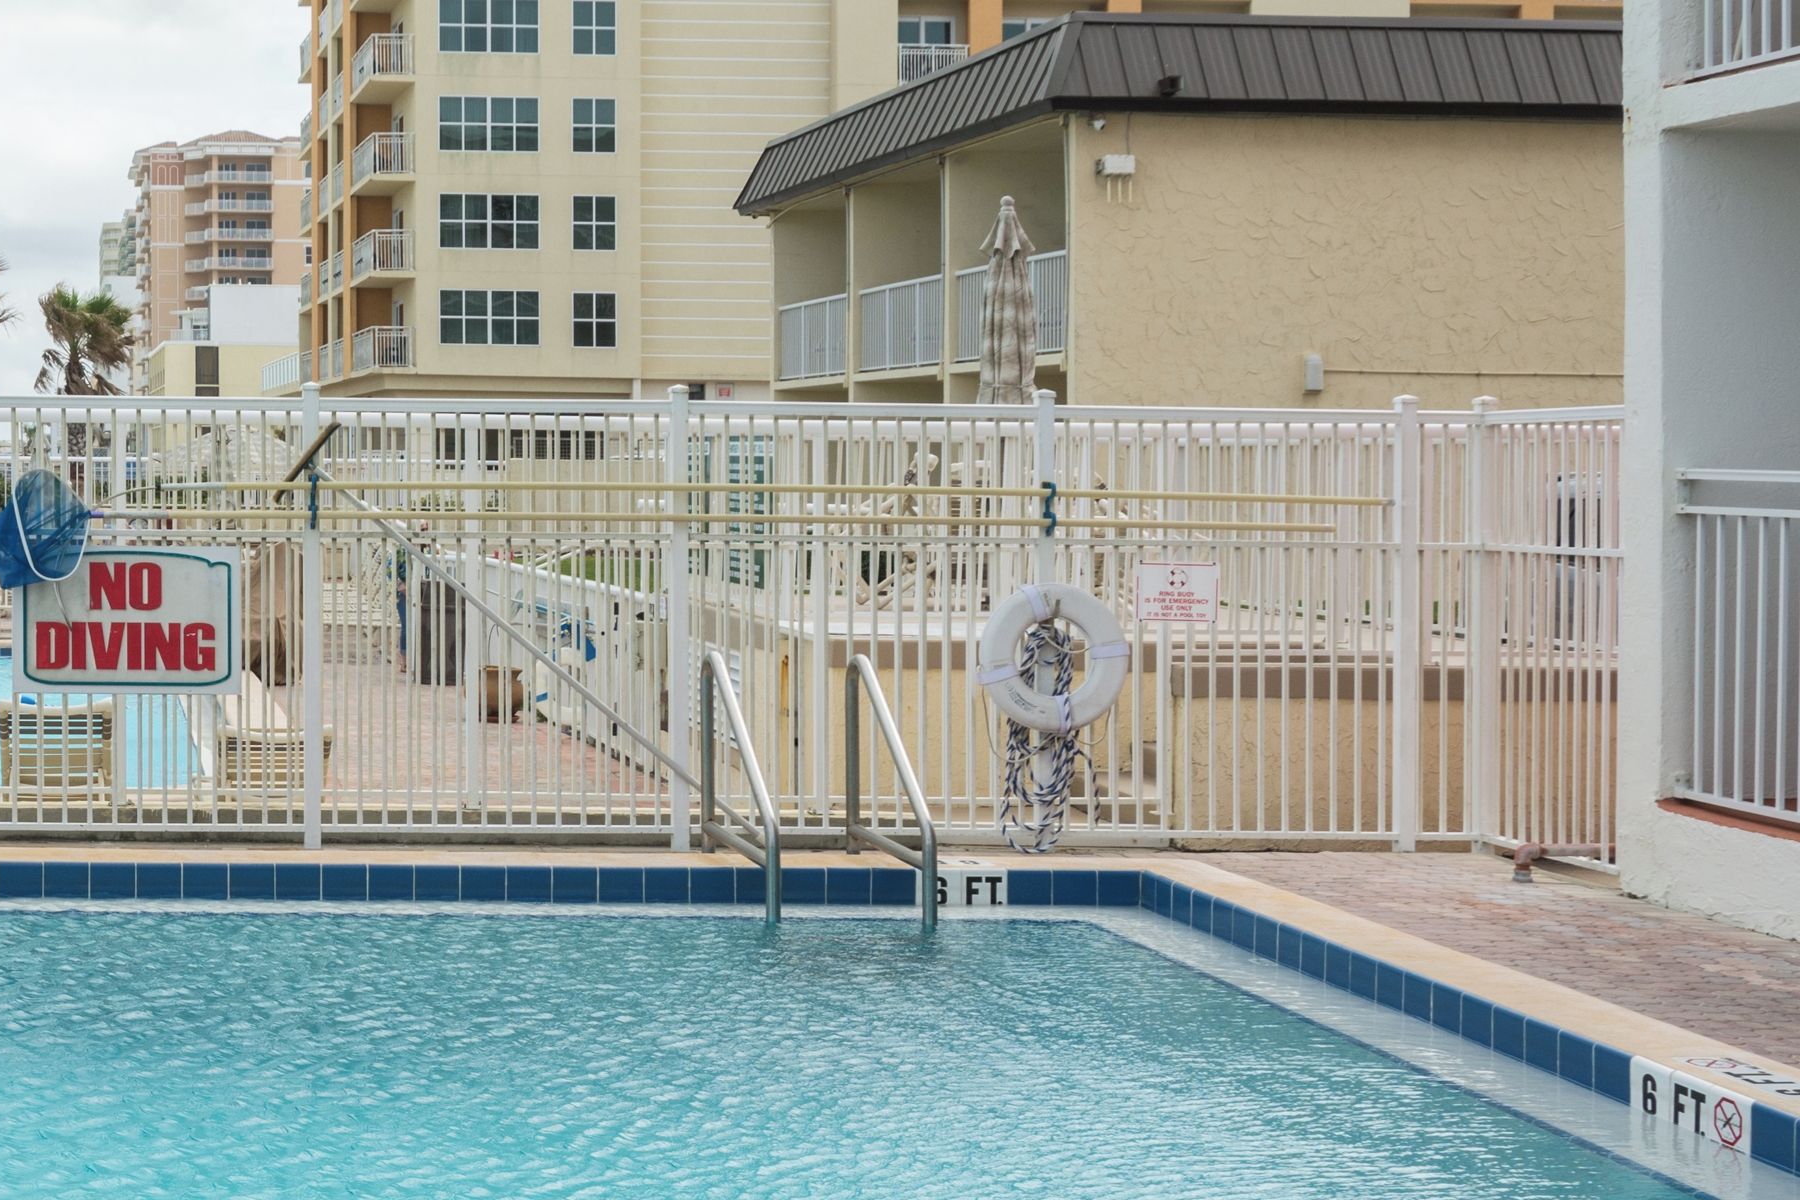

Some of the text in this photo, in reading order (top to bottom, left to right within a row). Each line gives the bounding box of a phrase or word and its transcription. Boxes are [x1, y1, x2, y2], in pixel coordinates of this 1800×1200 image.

[89, 561, 162, 611] NO
[36, 621, 216, 672] DIVING
[937, 876, 1004, 905] 6 FT.
[1641, 1073, 1658, 1115] 6
